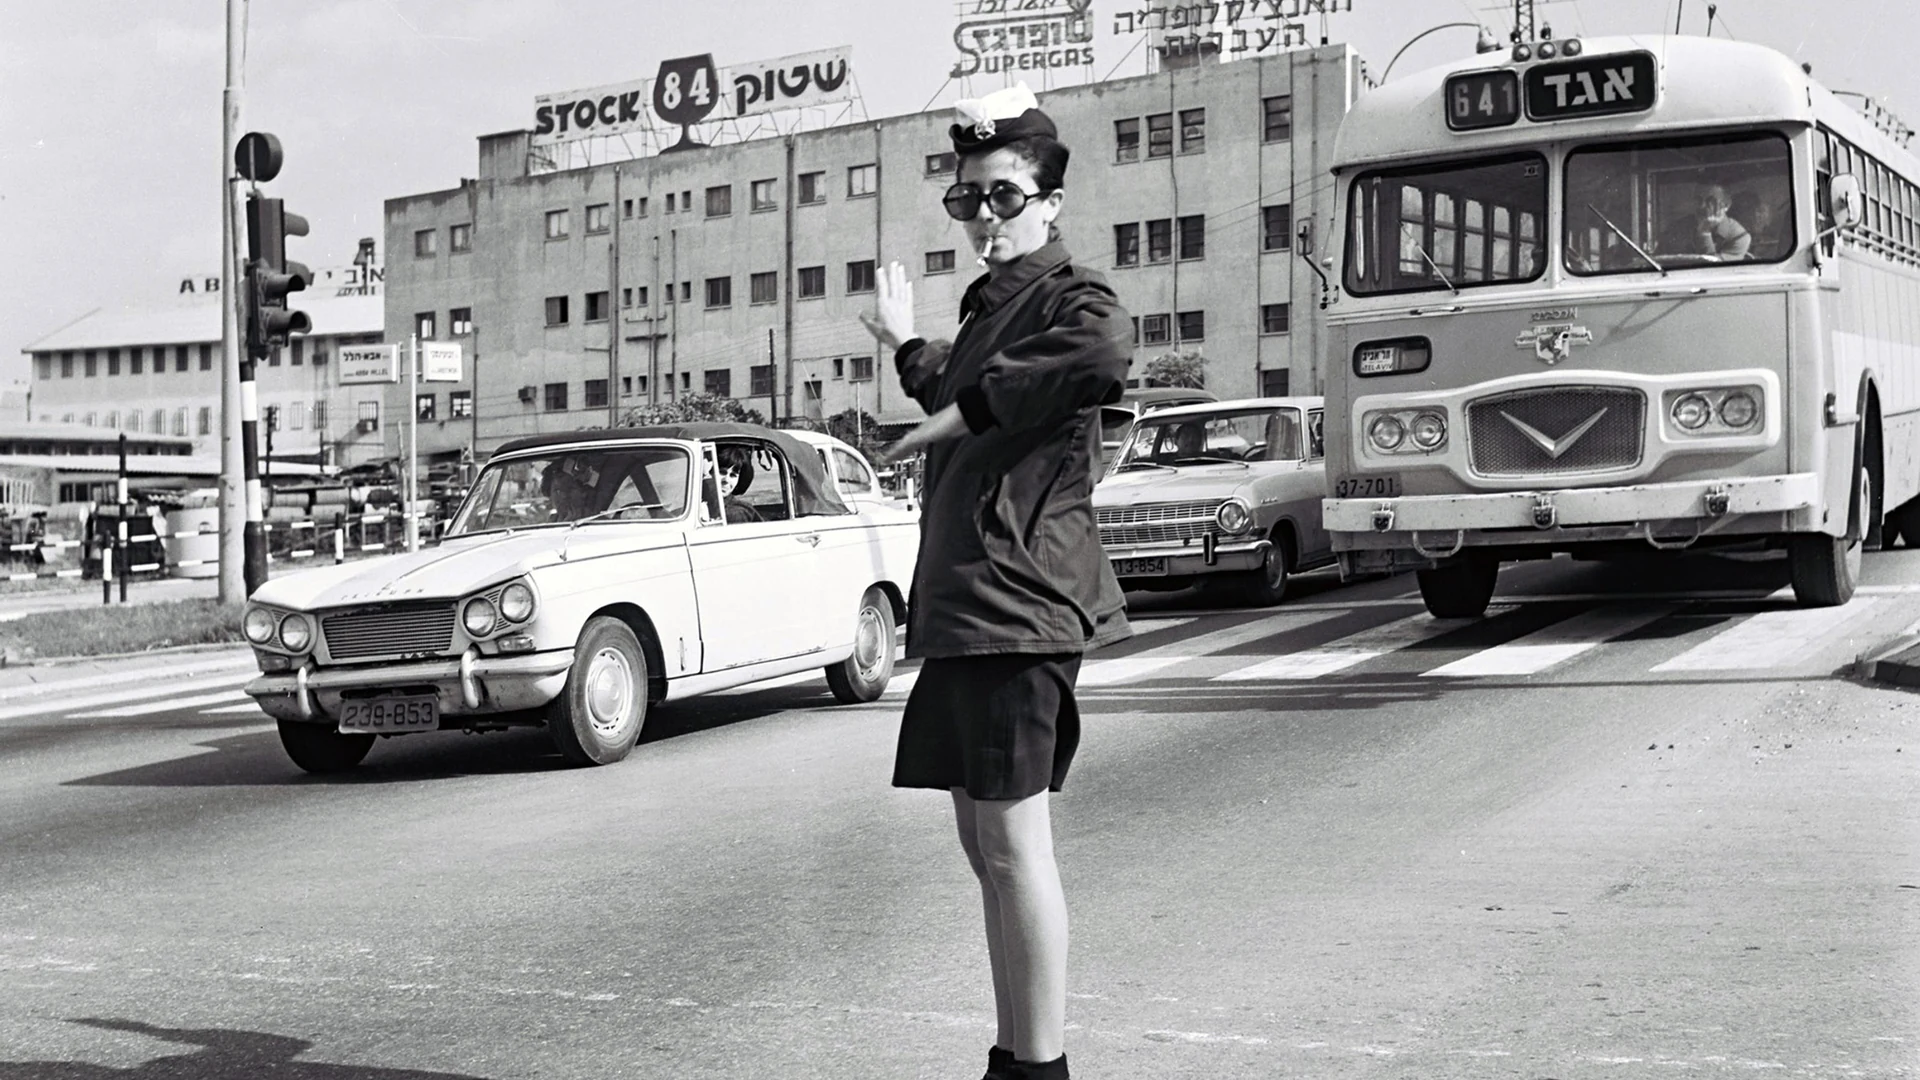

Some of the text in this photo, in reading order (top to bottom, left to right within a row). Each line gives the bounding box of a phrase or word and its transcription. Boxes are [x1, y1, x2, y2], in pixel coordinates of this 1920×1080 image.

[949, 27, 1095, 78] SUPERGAS
[1163, 24, 1305, 58] העברית
[662, 67, 711, 109] 84
[733, 57, 847, 116] שטוק
[1454, 79, 1516, 118] 641
[1543, 66, 1635, 108] אגד
[534, 90, 640, 135] STOCK
[344, 702, 433, 727] 239-853
